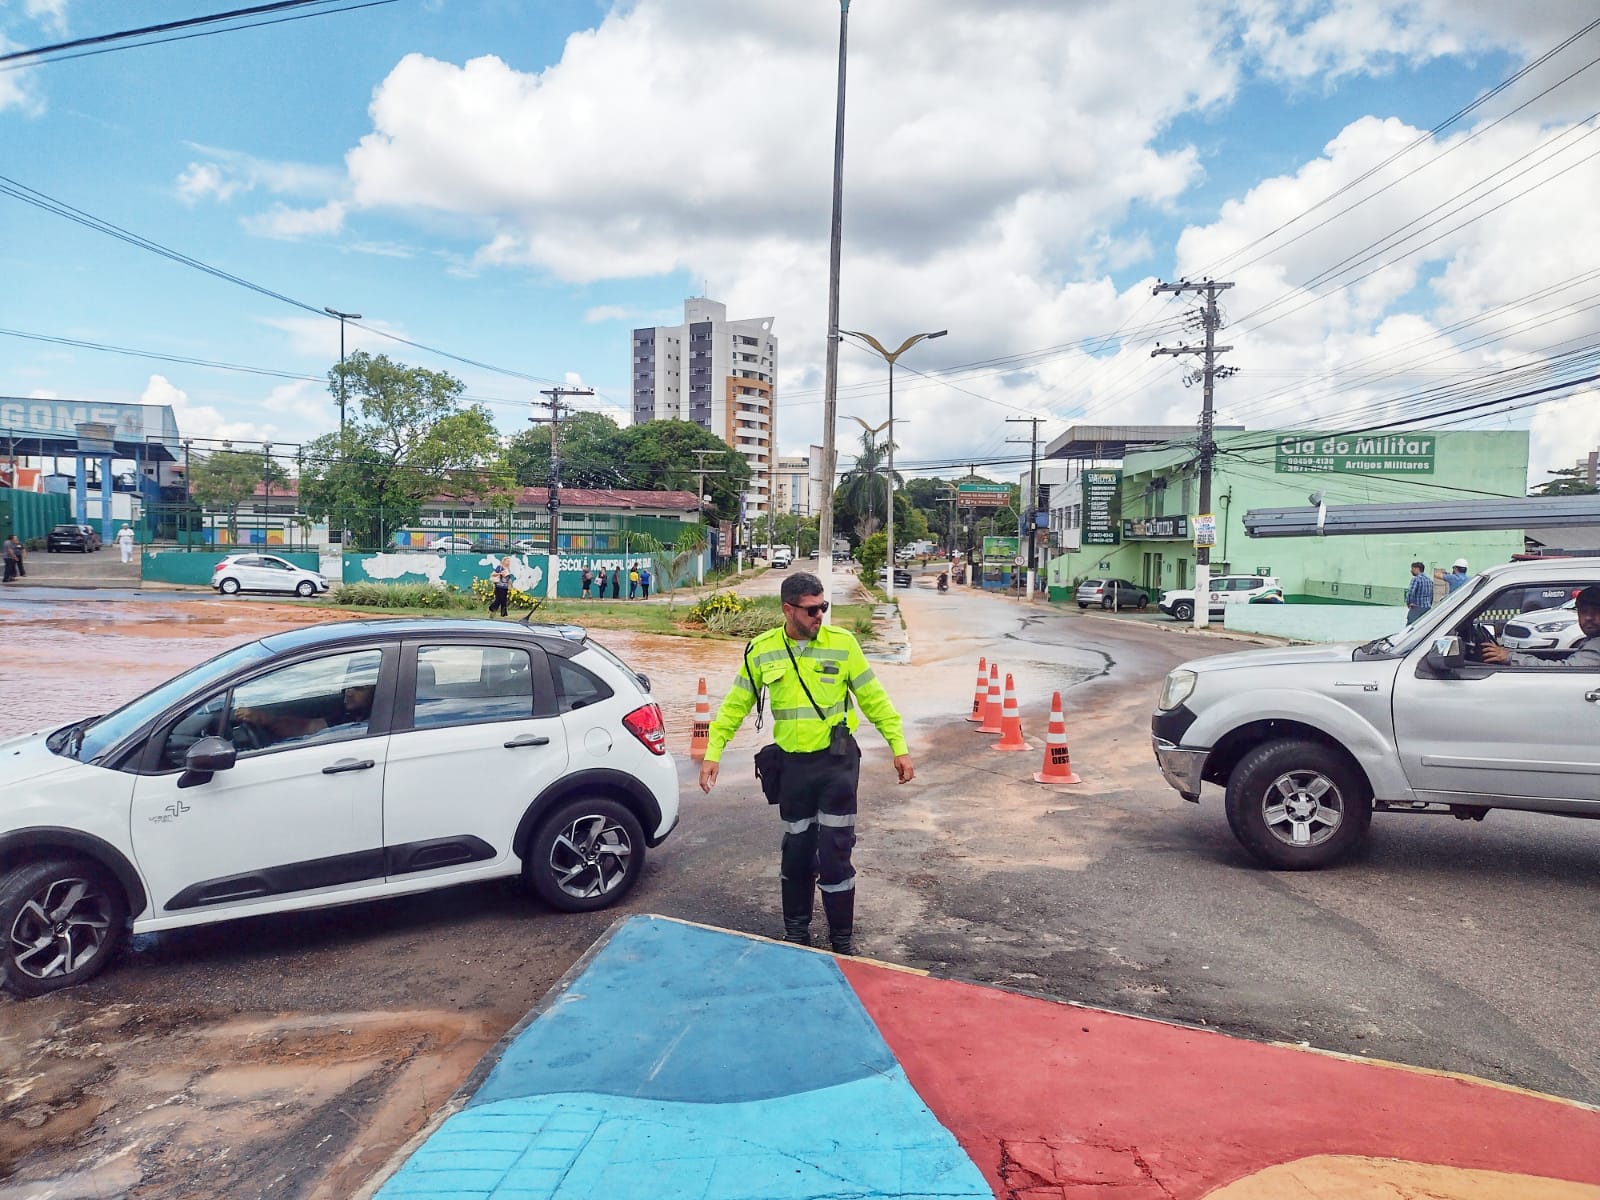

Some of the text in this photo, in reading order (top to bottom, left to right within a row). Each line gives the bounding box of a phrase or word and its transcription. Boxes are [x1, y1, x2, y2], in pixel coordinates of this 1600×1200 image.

[1281, 437, 1431, 455] Cia do Militar
[1345, 460, 1430, 470] Artigos Militares
